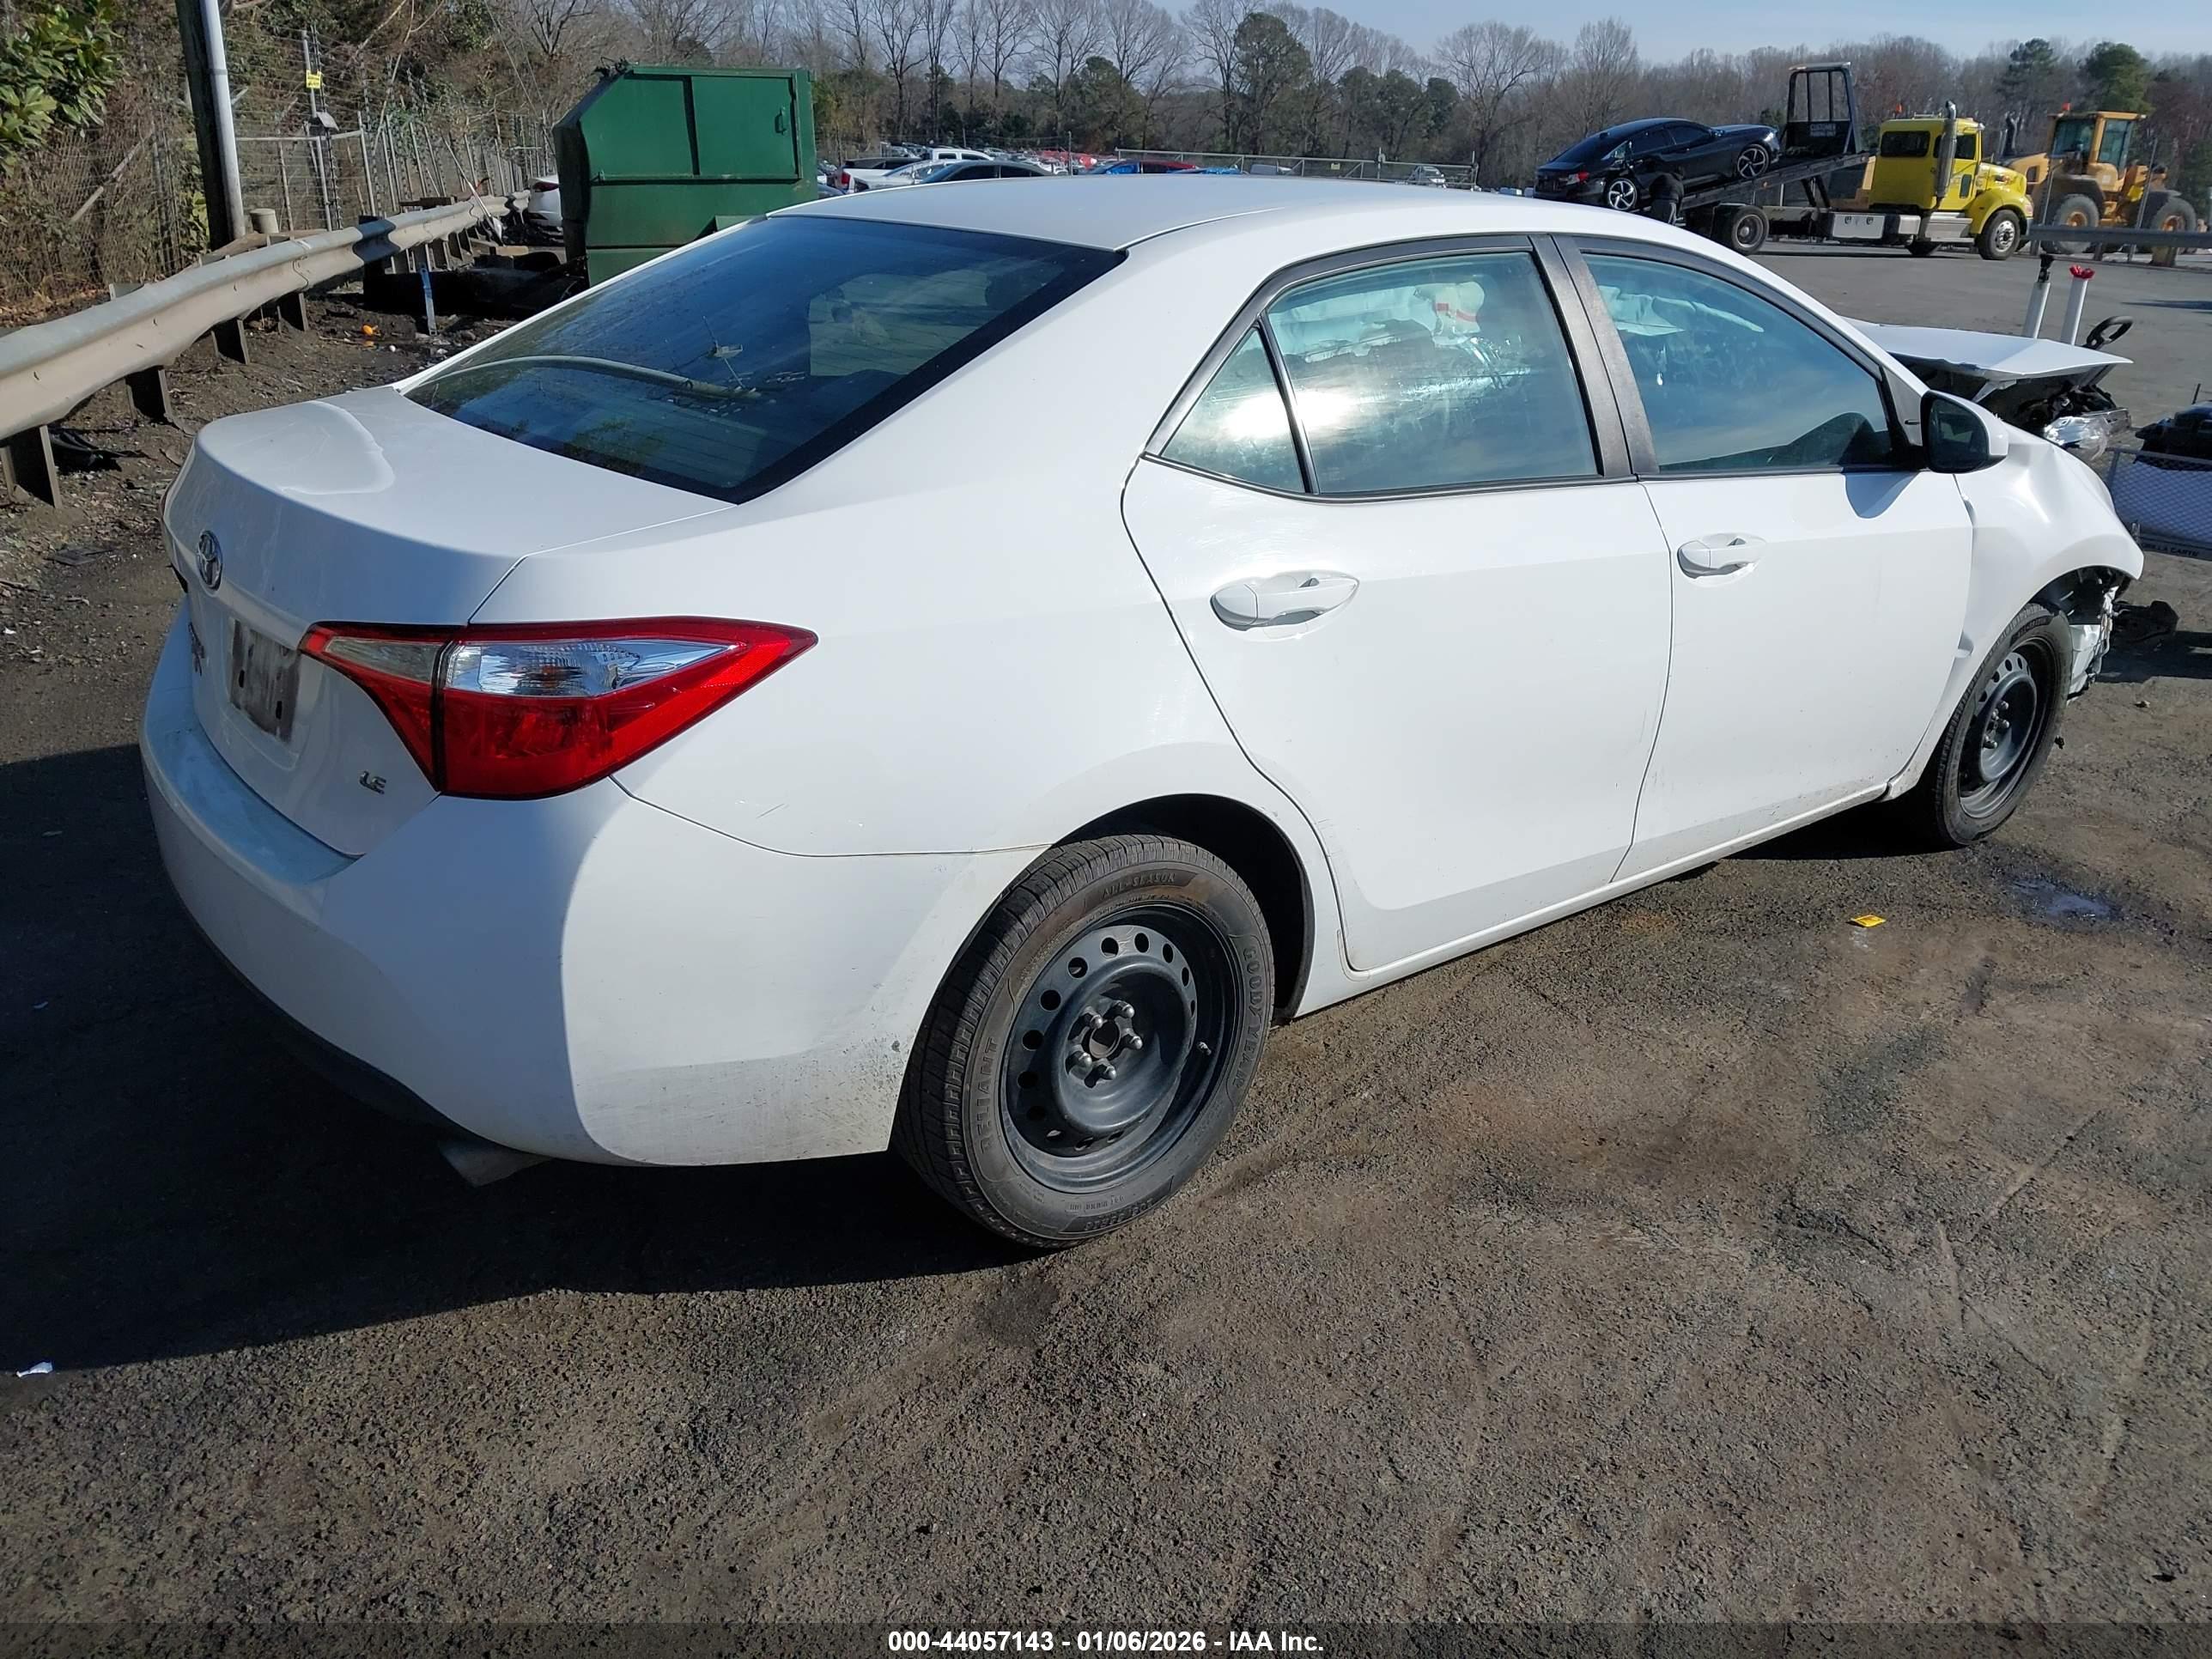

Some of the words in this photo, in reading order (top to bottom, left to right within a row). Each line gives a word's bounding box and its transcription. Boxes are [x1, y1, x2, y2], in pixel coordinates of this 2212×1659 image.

[359, 770, 387, 795] LE
[1233, 945, 1263, 1089] GOODYEAR
[976, 1037, 999, 1154] RELIANT
